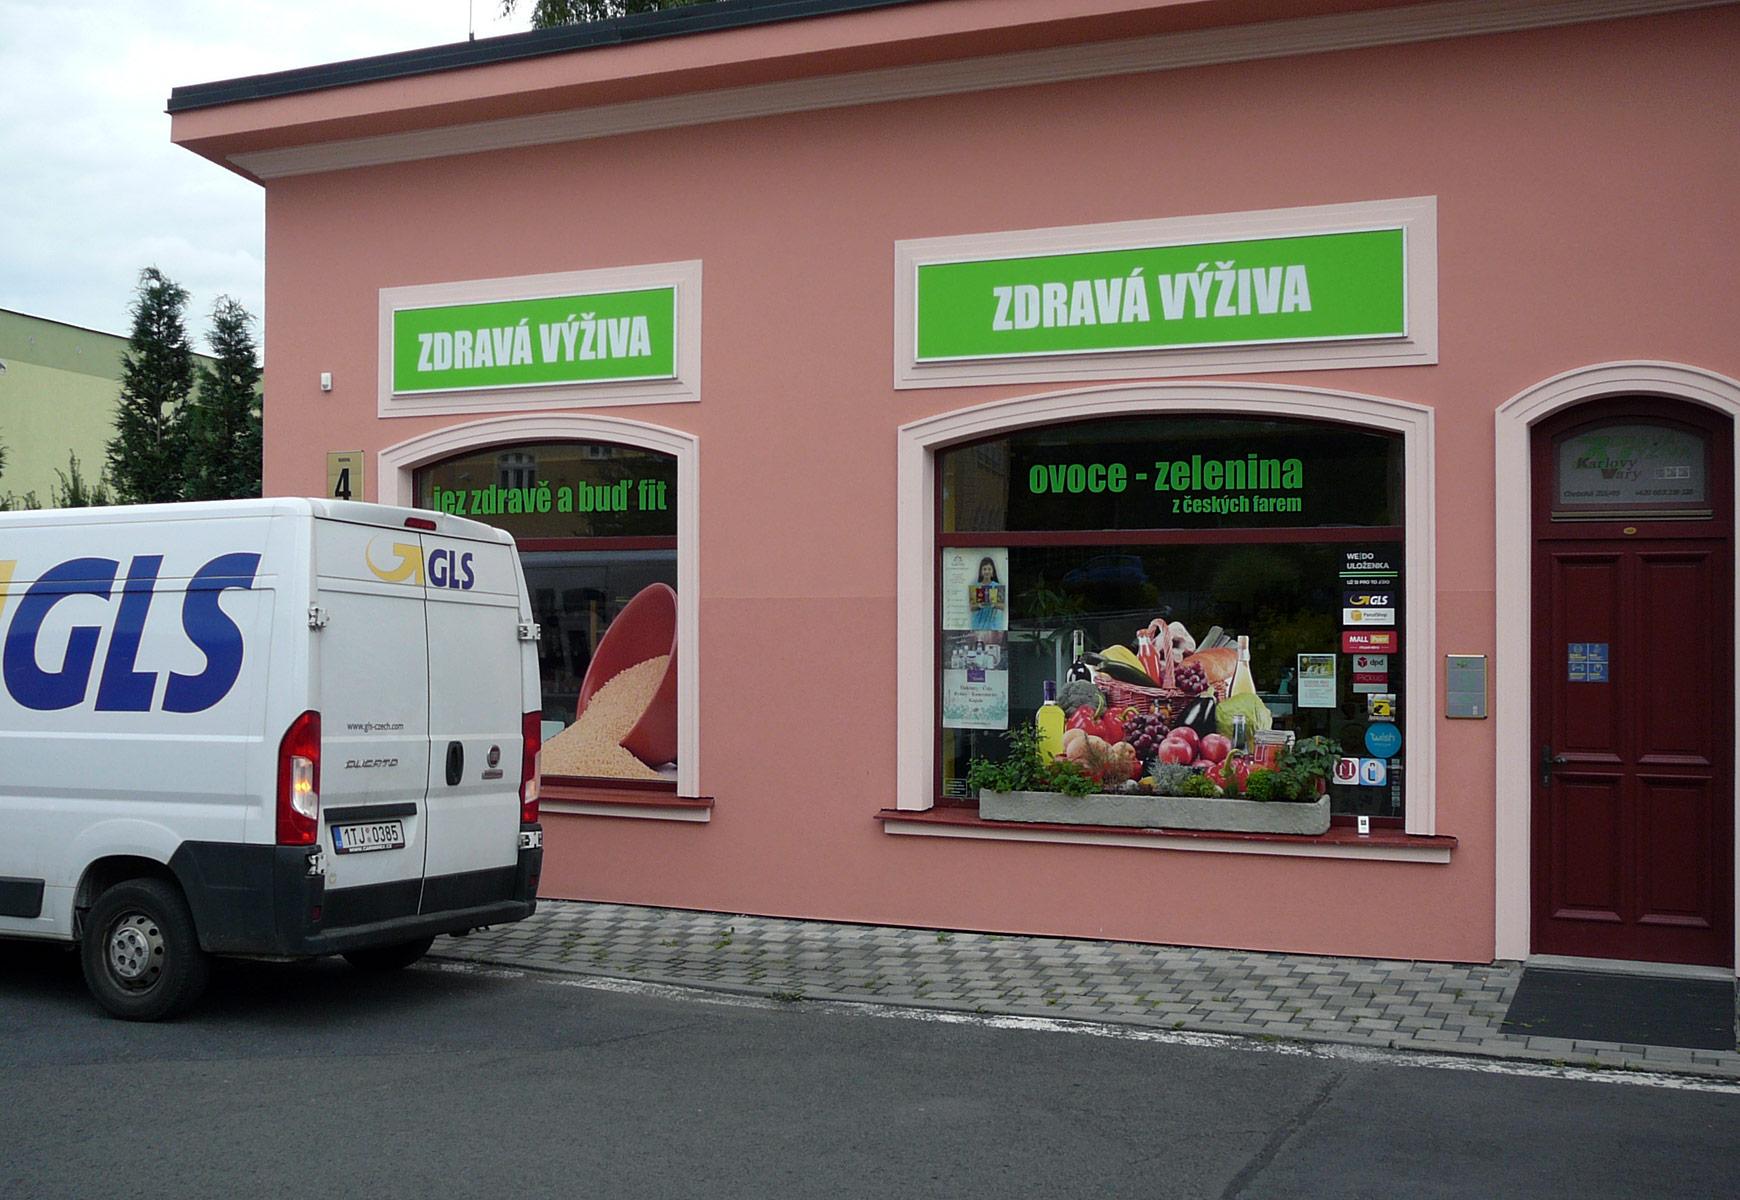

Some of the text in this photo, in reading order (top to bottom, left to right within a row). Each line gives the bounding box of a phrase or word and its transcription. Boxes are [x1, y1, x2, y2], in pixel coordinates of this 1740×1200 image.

[992, 259, 1312, 332] ZDRAVÁ VÝŽIVA
[417, 312, 652, 372] ZDRAVÁ VÝŽIVA
[335, 468, 352, 500] 4
[1028, 462, 1127, 495] ovoce
[1154, 453, 1303, 492] zelenina
[433, 479, 667, 515] jez zdravě a buď fit
[1172, 495, 1302, 516] z českých farem
[428, 548, 475, 590] GLS
[1346, 561, 1389, 569] ULOŽENKA
[1370, 596, 1388, 605] GLS
[2, 552, 262, 713] GLS
[1370, 658, 1384, 667] dpd
[345, 759, 399, 769] DUCATO
[344, 827, 366, 846] 1TJ
[372, 824, 399, 843] 0385
